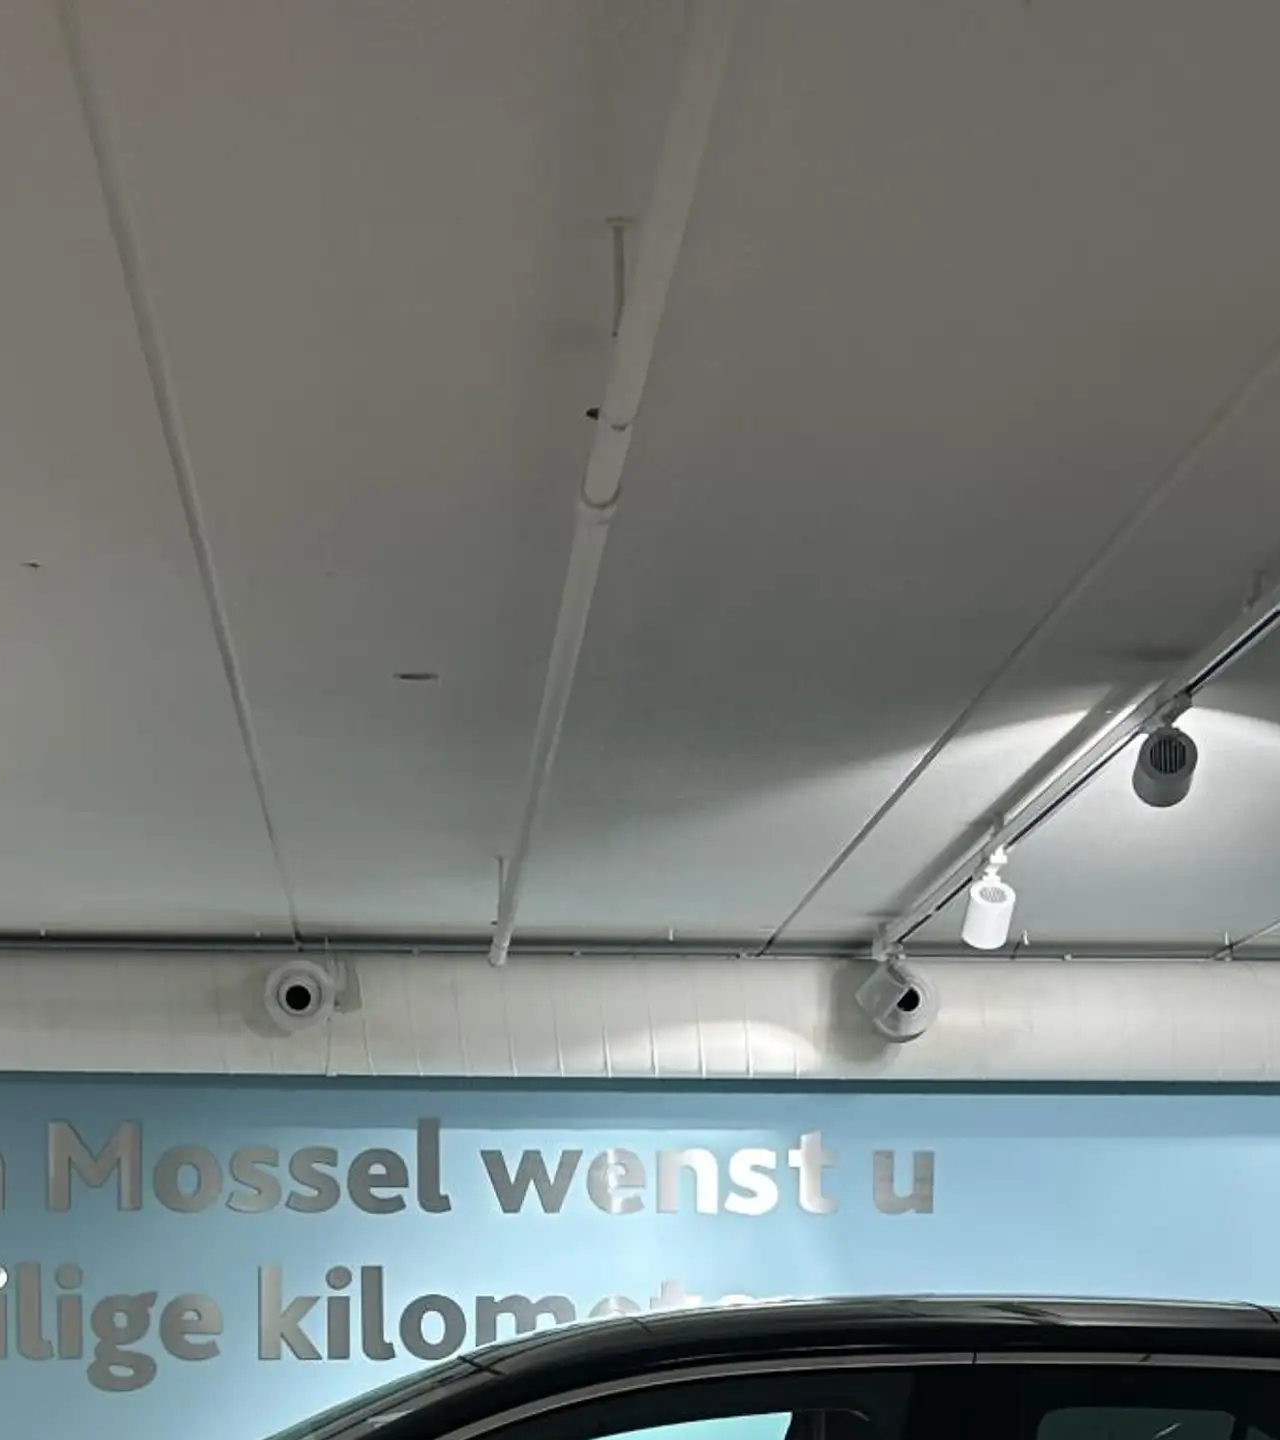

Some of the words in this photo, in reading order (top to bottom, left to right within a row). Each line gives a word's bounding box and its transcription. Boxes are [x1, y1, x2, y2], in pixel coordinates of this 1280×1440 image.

[47, 1117, 452, 1214] Mossel
[479, 1130, 838, 1216] wenst
[872, 1149, 936, 1215] u
[257, 1263, 760, 1361] kilom
